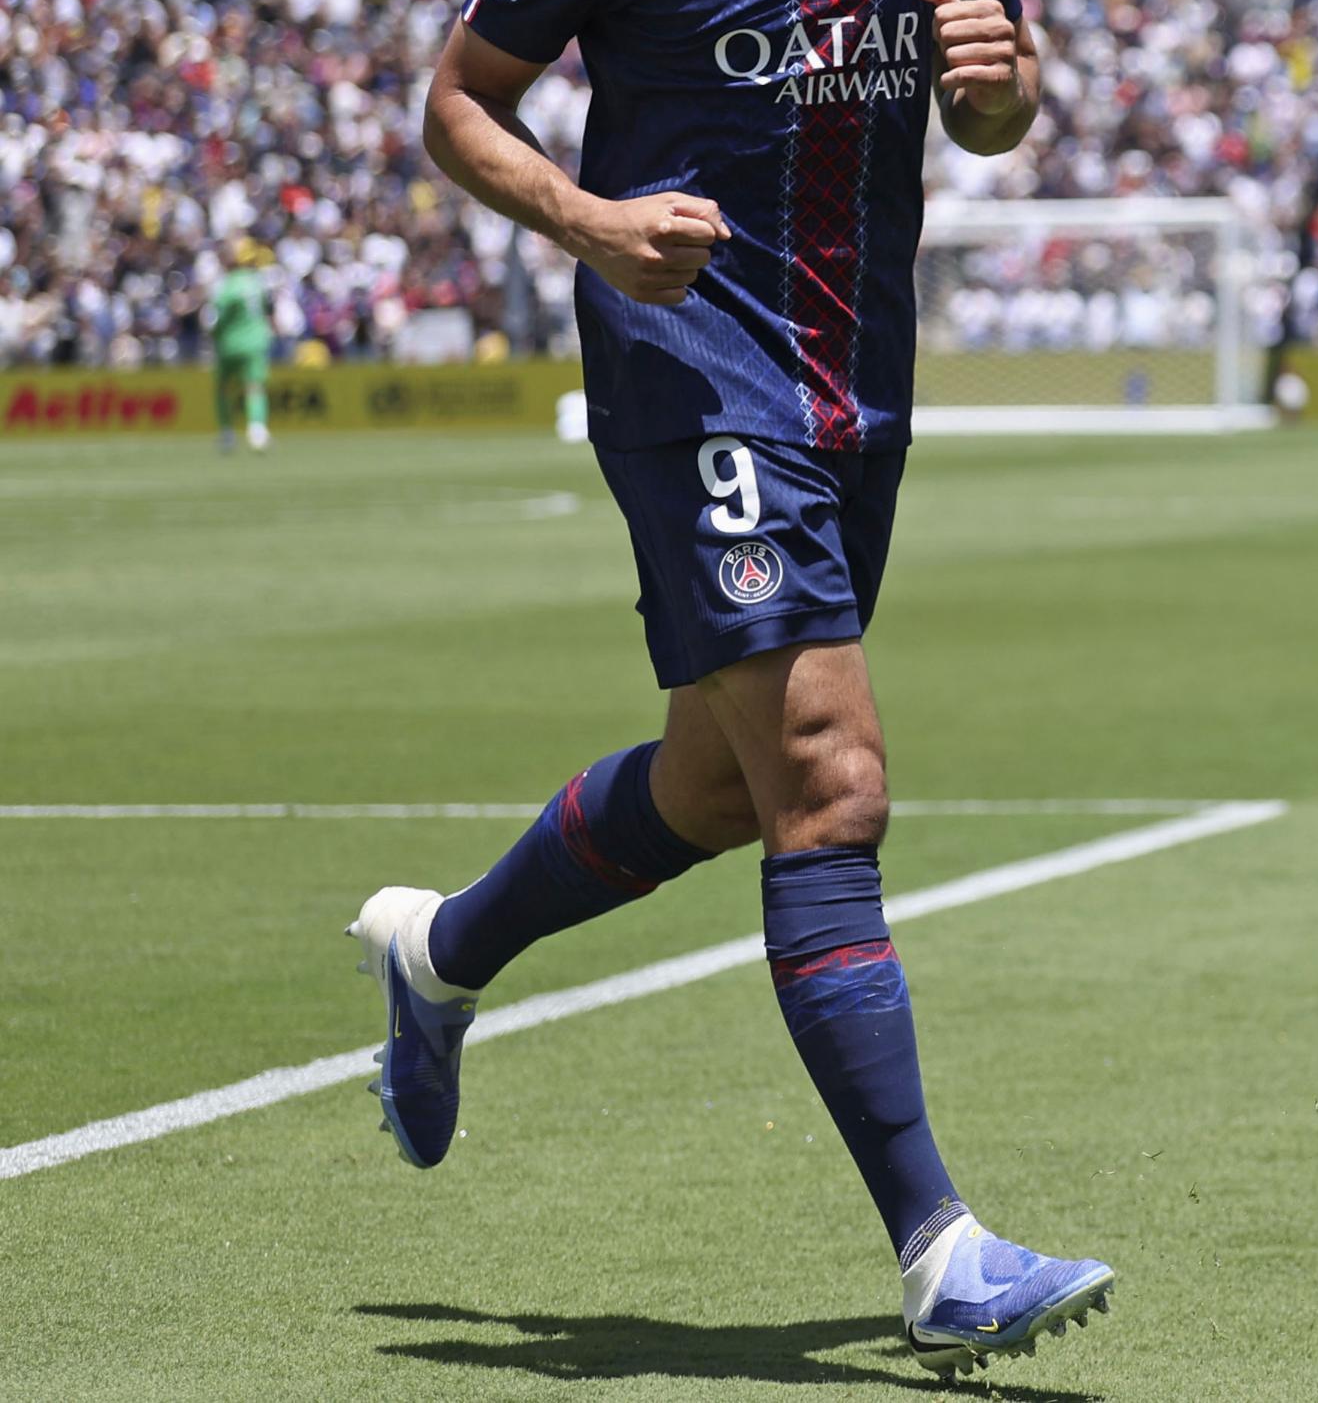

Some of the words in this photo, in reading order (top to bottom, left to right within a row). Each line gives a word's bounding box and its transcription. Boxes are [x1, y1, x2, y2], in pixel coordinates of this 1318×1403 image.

[714, 11, 919, 85] QATAR
[775, 65, 916, 105] AIRWAYS
[4, 381, 179, 428] Active
[697, 435, 760, 533] 9
[726, 545, 767, 564] PARIS
